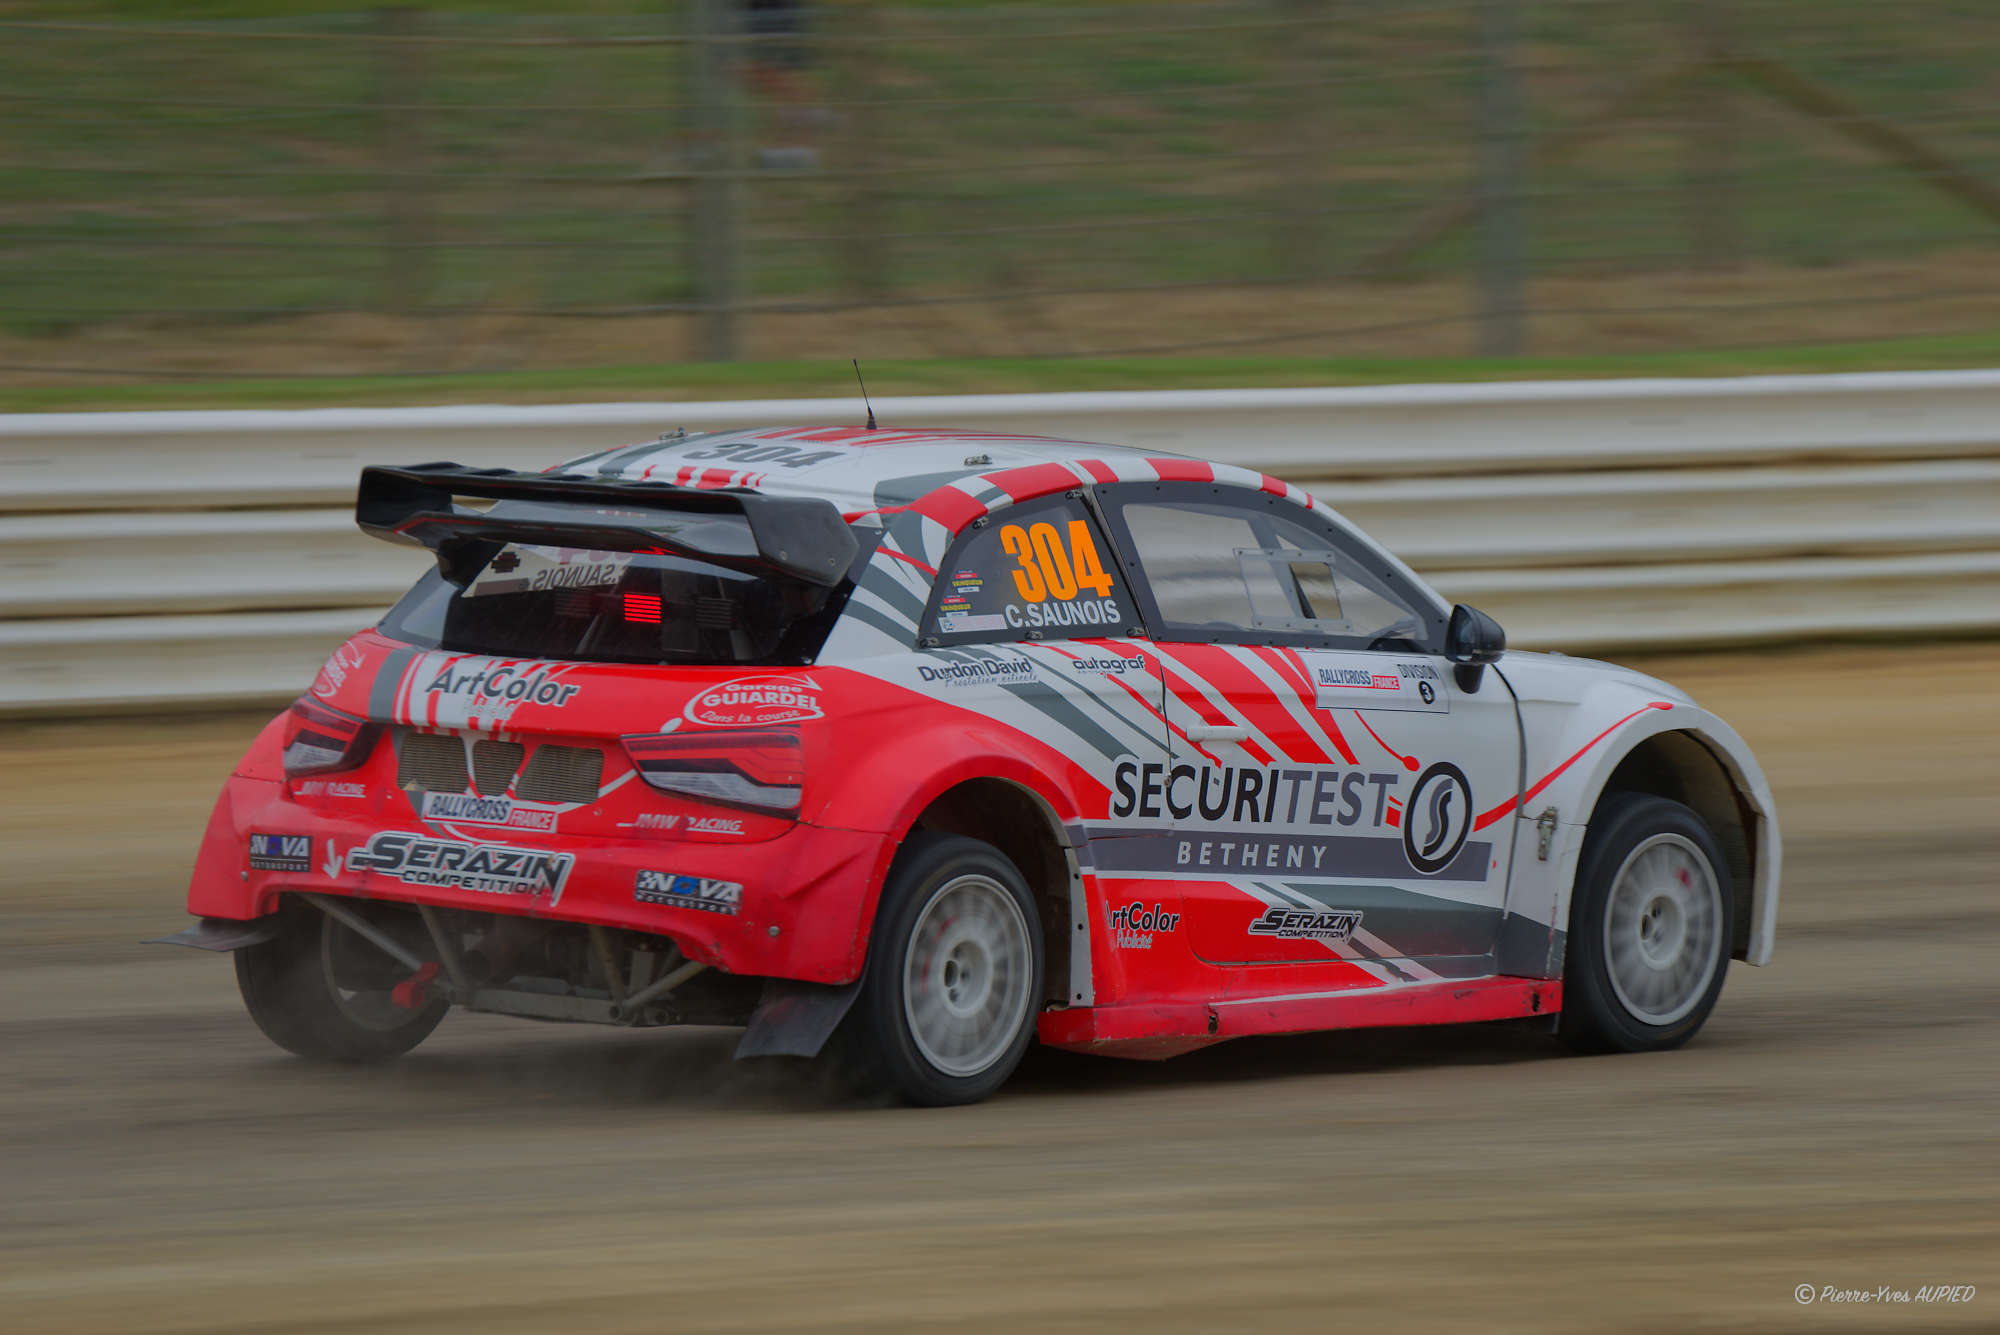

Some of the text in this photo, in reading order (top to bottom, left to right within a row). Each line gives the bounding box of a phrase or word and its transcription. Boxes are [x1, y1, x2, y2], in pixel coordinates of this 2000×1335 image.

[682, 443, 846, 468] 304
[1000, 519, 1114, 603] 304
[1005, 599, 1121, 628] C.SAUNOIS
[983, 657, 1033, 675] David
[1072, 656, 1145, 674] autograf
[1319, 669, 1371, 685] RALLYCROSS
[1397, 664, 1439, 680] DIVISION
[425, 666, 579, 706] ArtColor
[725, 684, 803, 693] Garage
[703, 692, 821, 710] GUIARDEL
[701, 709, 801, 723] Dans la course
[1113, 761, 1398, 827] SECURITEST
[429, 795, 552, 829] RALLYCROSS FRANCE
[351, 836, 567, 894] SERAZIN
[1177, 841, 1327, 869] BETHENY
[402, 870, 550, 894] COMPETITION
[637, 871, 743, 902] NOVA
[1253, 909, 1361, 938] SERAZIN
[1279, 929, 1345, 939] COMPETITION
